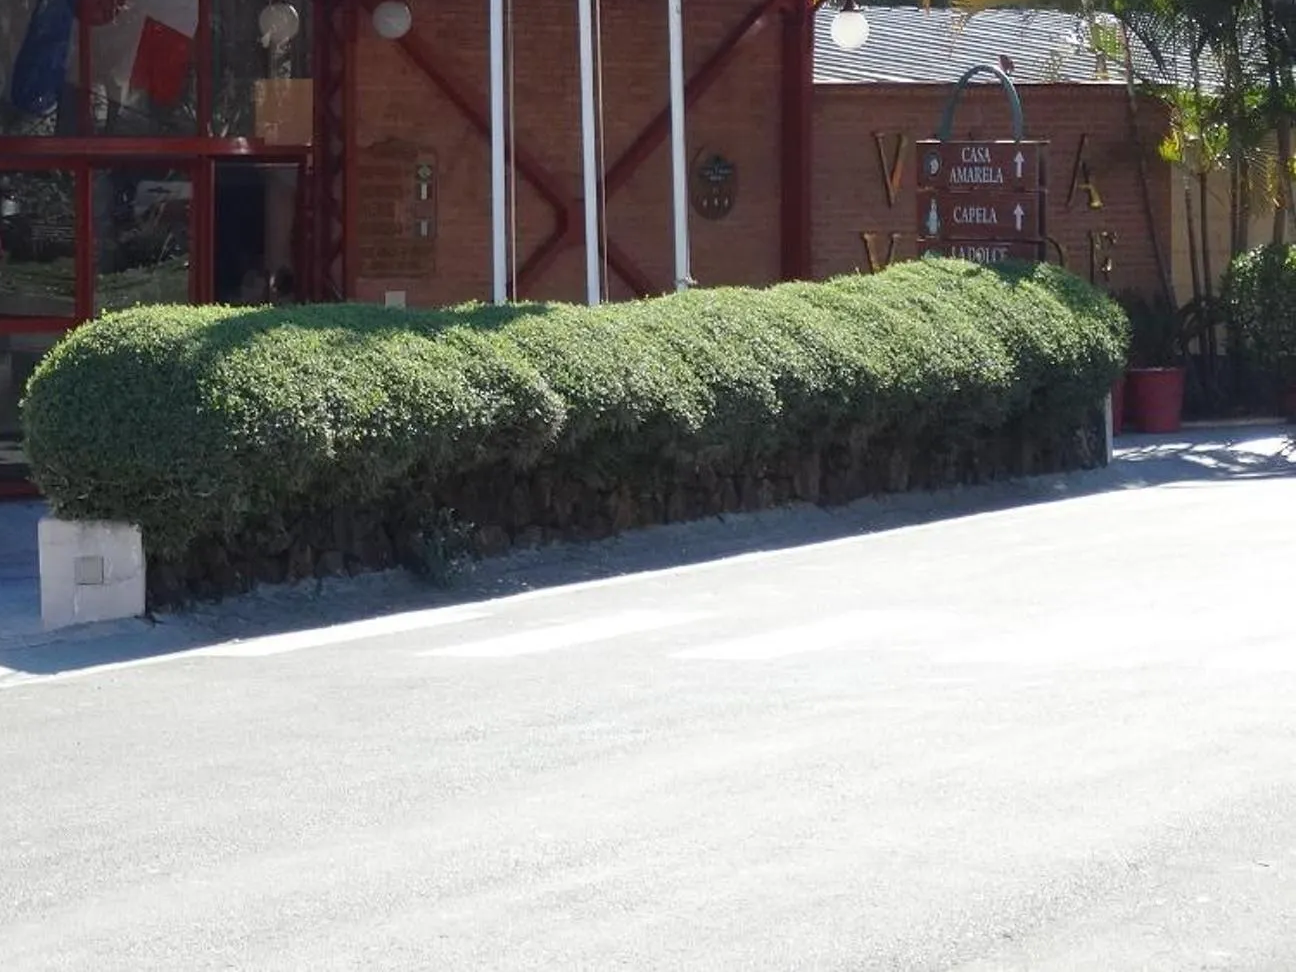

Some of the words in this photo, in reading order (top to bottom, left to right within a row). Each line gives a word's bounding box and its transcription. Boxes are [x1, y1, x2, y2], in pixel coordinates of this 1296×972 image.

[961, 147, 991, 163] CASA
[949, 167, 1004, 184] AMARELA
[953, 206, 998, 224] CAPELA
